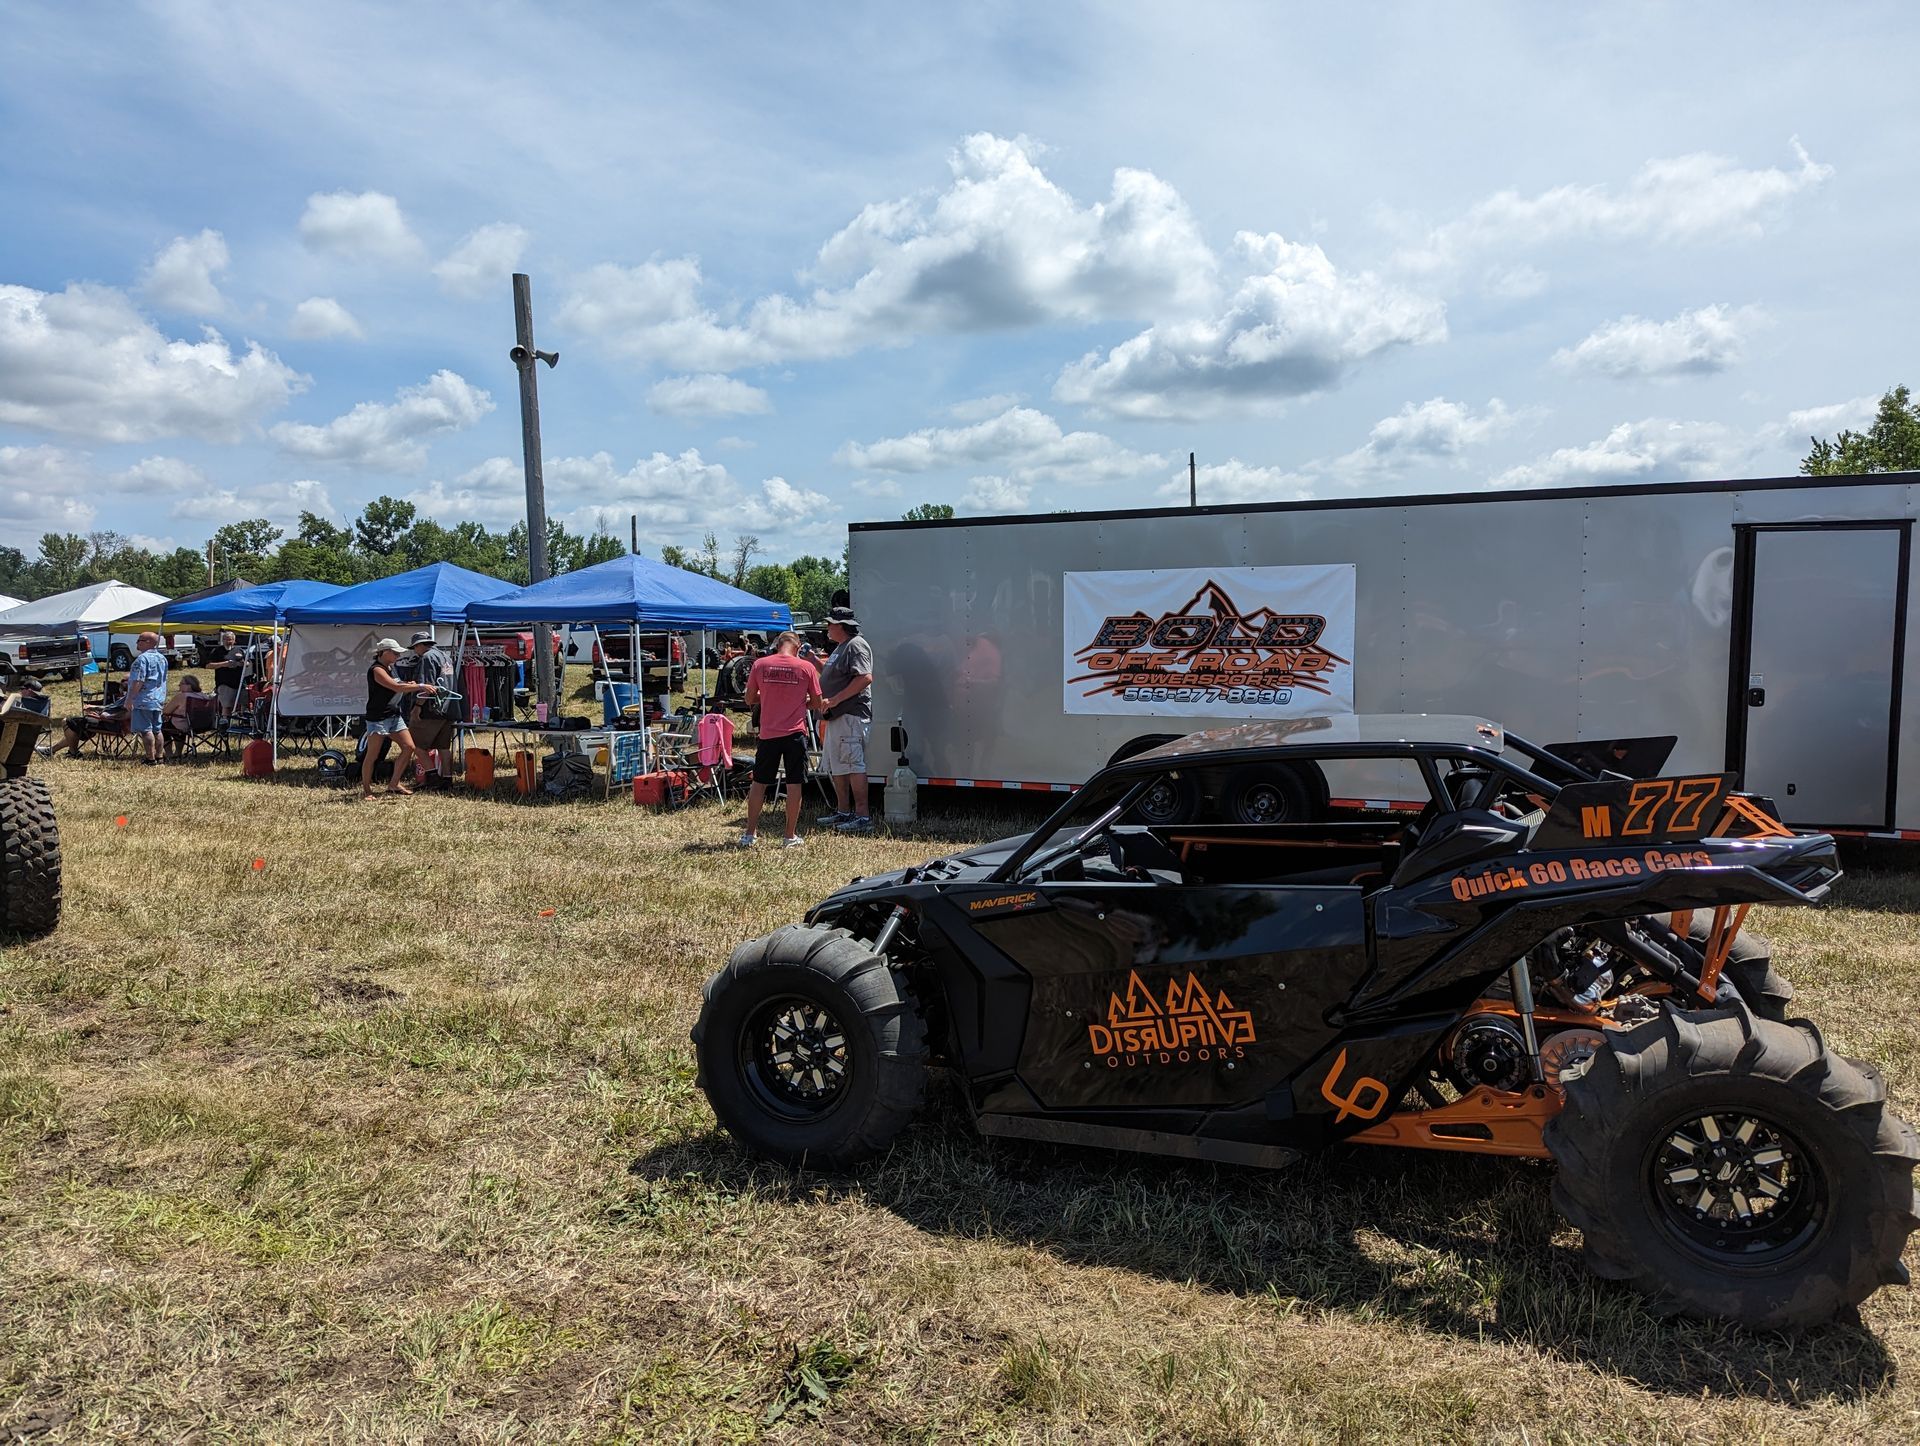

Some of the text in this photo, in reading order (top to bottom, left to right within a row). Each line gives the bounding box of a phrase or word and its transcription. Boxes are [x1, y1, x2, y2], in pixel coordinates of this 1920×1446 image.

[1091, 615, 1327, 649] BOLD
[1088, 652, 1331, 671] OFF-ROAD
[1117, 673, 1295, 686] POWERSPORTS
[1122, 687, 1293, 705] 563-277-8830
[1582, 778, 1721, 838] M 77
[1452, 850, 1712, 902] Quick 60 Race Cars
[969, 892, 1037, 911] MAVERICK
[1088, 1011, 1257, 1055] DISRUPTIVE
[1107, 1046, 1245, 1068] OUTDOORS
